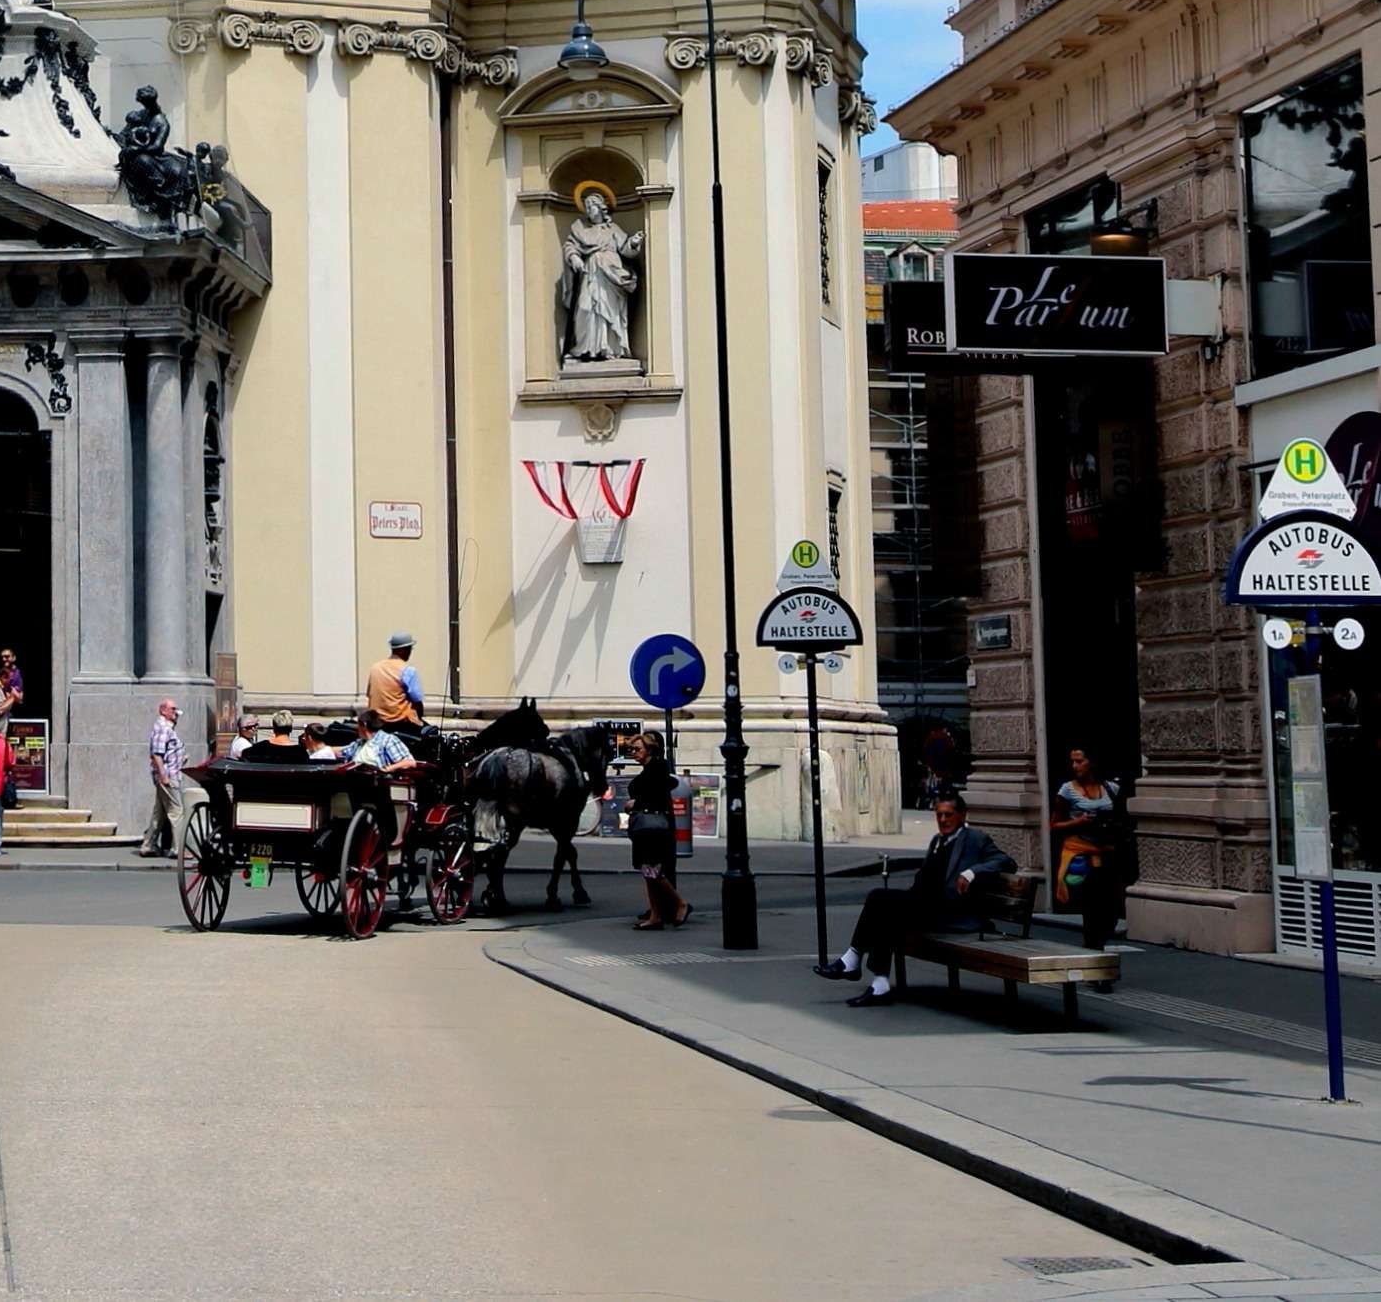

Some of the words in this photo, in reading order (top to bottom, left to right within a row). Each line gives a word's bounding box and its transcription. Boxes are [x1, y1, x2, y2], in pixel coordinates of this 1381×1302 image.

[1024, 266, 1076, 304] Le
[1295, 449, 1316, 476] H
[1268, 526, 1355, 557] AUTOBUS
[799, 545, 814, 563] H
[1252, 575, 1370, 591] HALTESTELLE
[781, 595, 838, 616] AUTOBUS
[771, 626, 848, 637] HALTESTELLE
[1271, 629, 1285, 642] 1A
[1341, 628, 1357, 641] 2A
